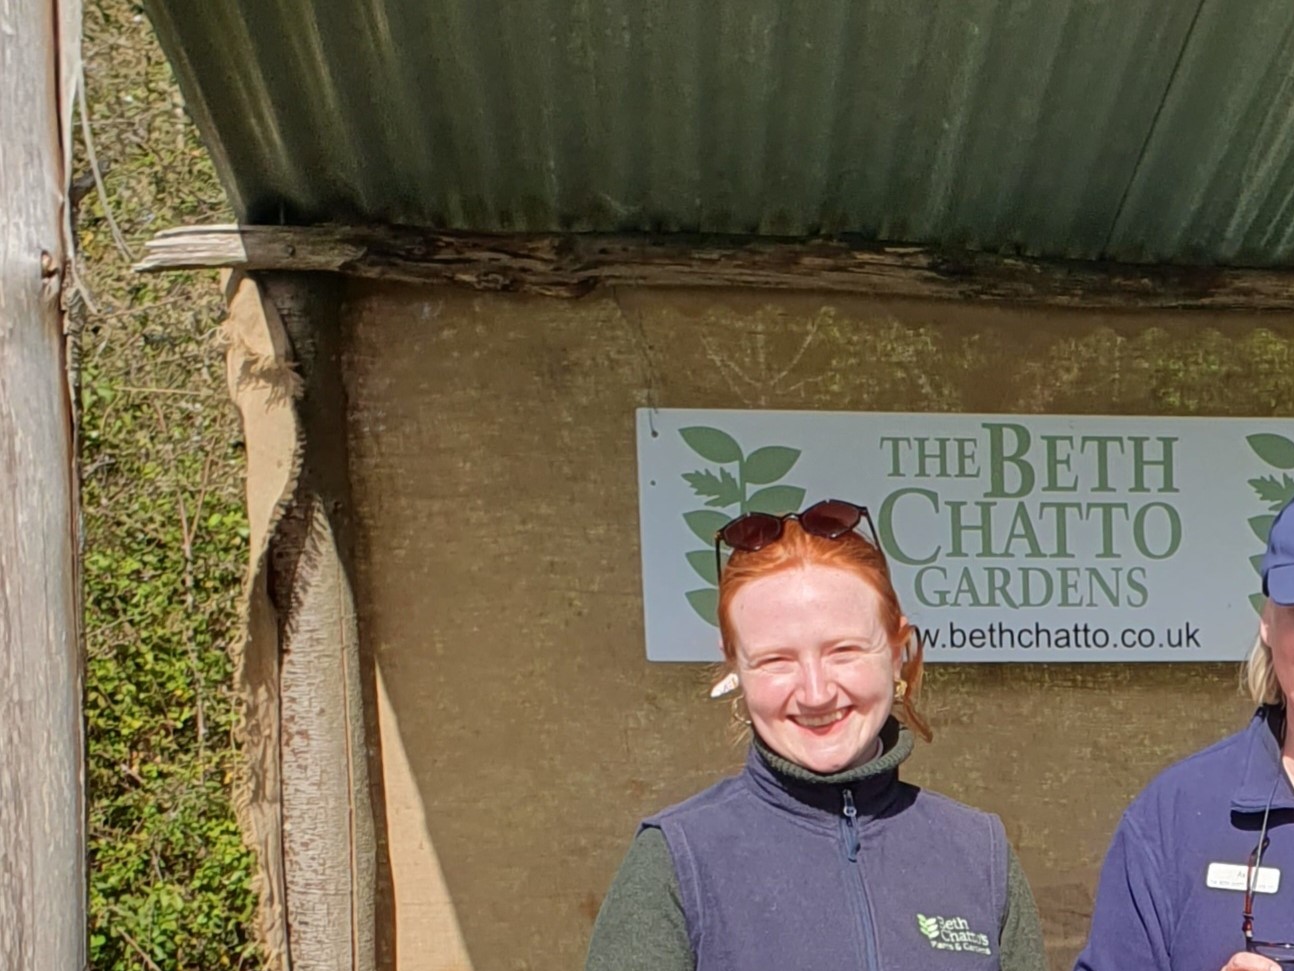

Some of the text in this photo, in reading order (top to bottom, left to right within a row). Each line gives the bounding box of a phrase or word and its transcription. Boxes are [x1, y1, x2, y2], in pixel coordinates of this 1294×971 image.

[879, 422, 1181, 498] THE BETH
[877, 486, 1183, 566] CHATTO
[913, 566, 1149, 610] GARDENS
[919, 620, 1202, 649] w.bethchatto.co.uk
